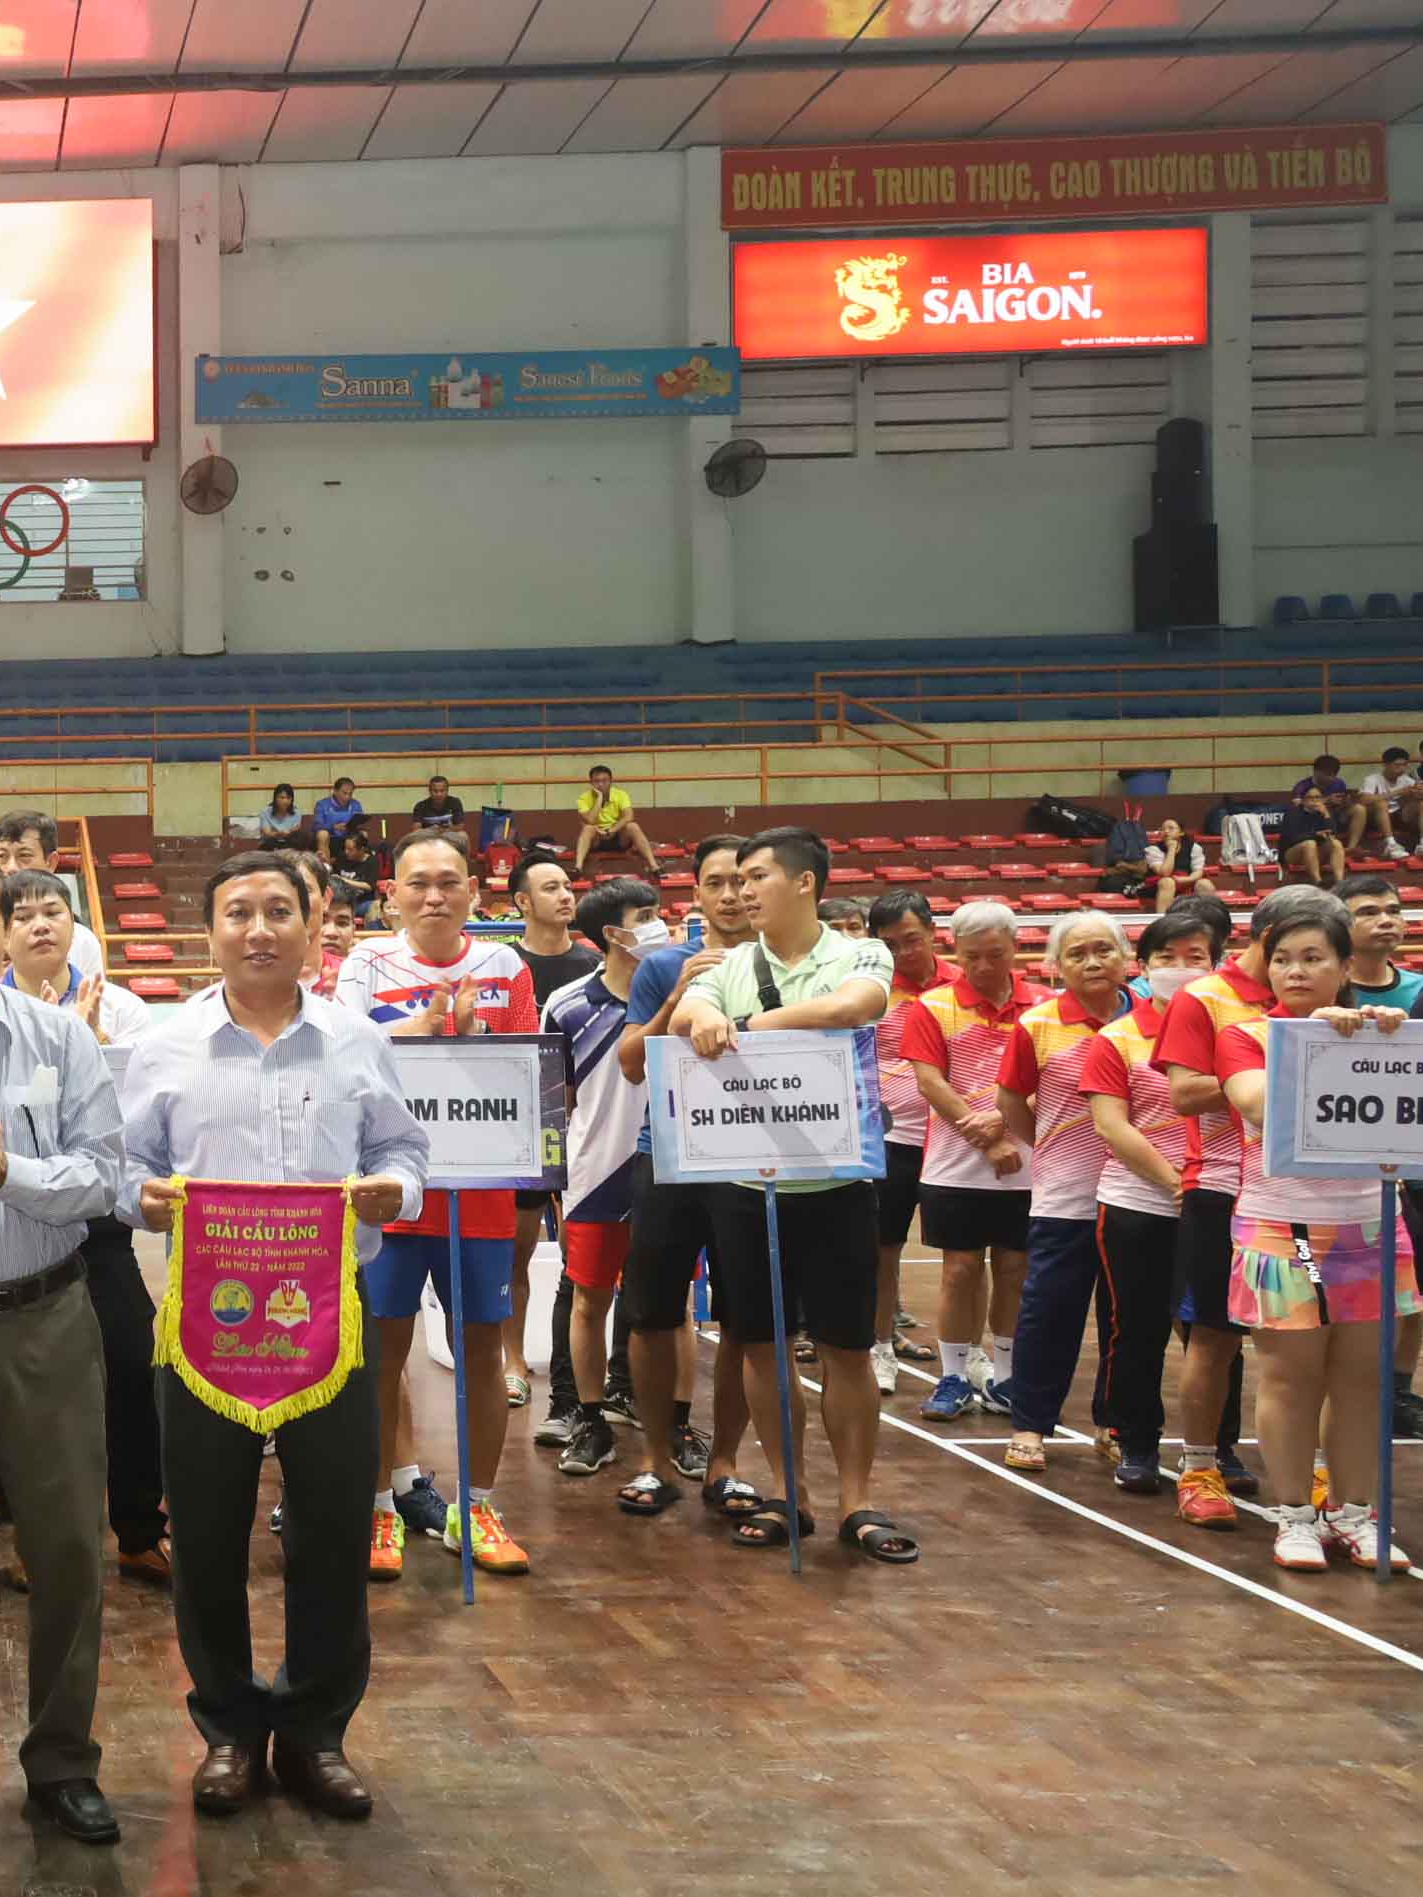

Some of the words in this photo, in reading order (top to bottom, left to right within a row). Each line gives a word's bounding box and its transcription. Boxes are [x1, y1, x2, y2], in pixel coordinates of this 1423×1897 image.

[732, 165, 802, 210] ĐOÀN
[873, 166, 955, 206] TRUNG
[1049, 159, 1101, 199] CAO
[1109, 151, 1216, 204] THƯỢNG
[1223, 144, 1259, 190] VÀ
[1335, 138, 1372, 193] BỘ
[981, 262, 1035, 285] BIA
[321, 366, 412, 397] Sanna
[1385, 1061, 1411, 1078] LẠC
[753, 1078, 779, 1093] LẠC
[447, 1098, 518, 1121] RANH
[691, 1108, 714, 1126] SH
[721, 1103, 765, 1125] DIÊN
[771, 1100, 840, 1123] KHÁNH
[1316, 1094, 1384, 1124] SAO
[279, 1223, 318, 1241] LÔNG
[1294, 1238, 1312, 1260] Golf
